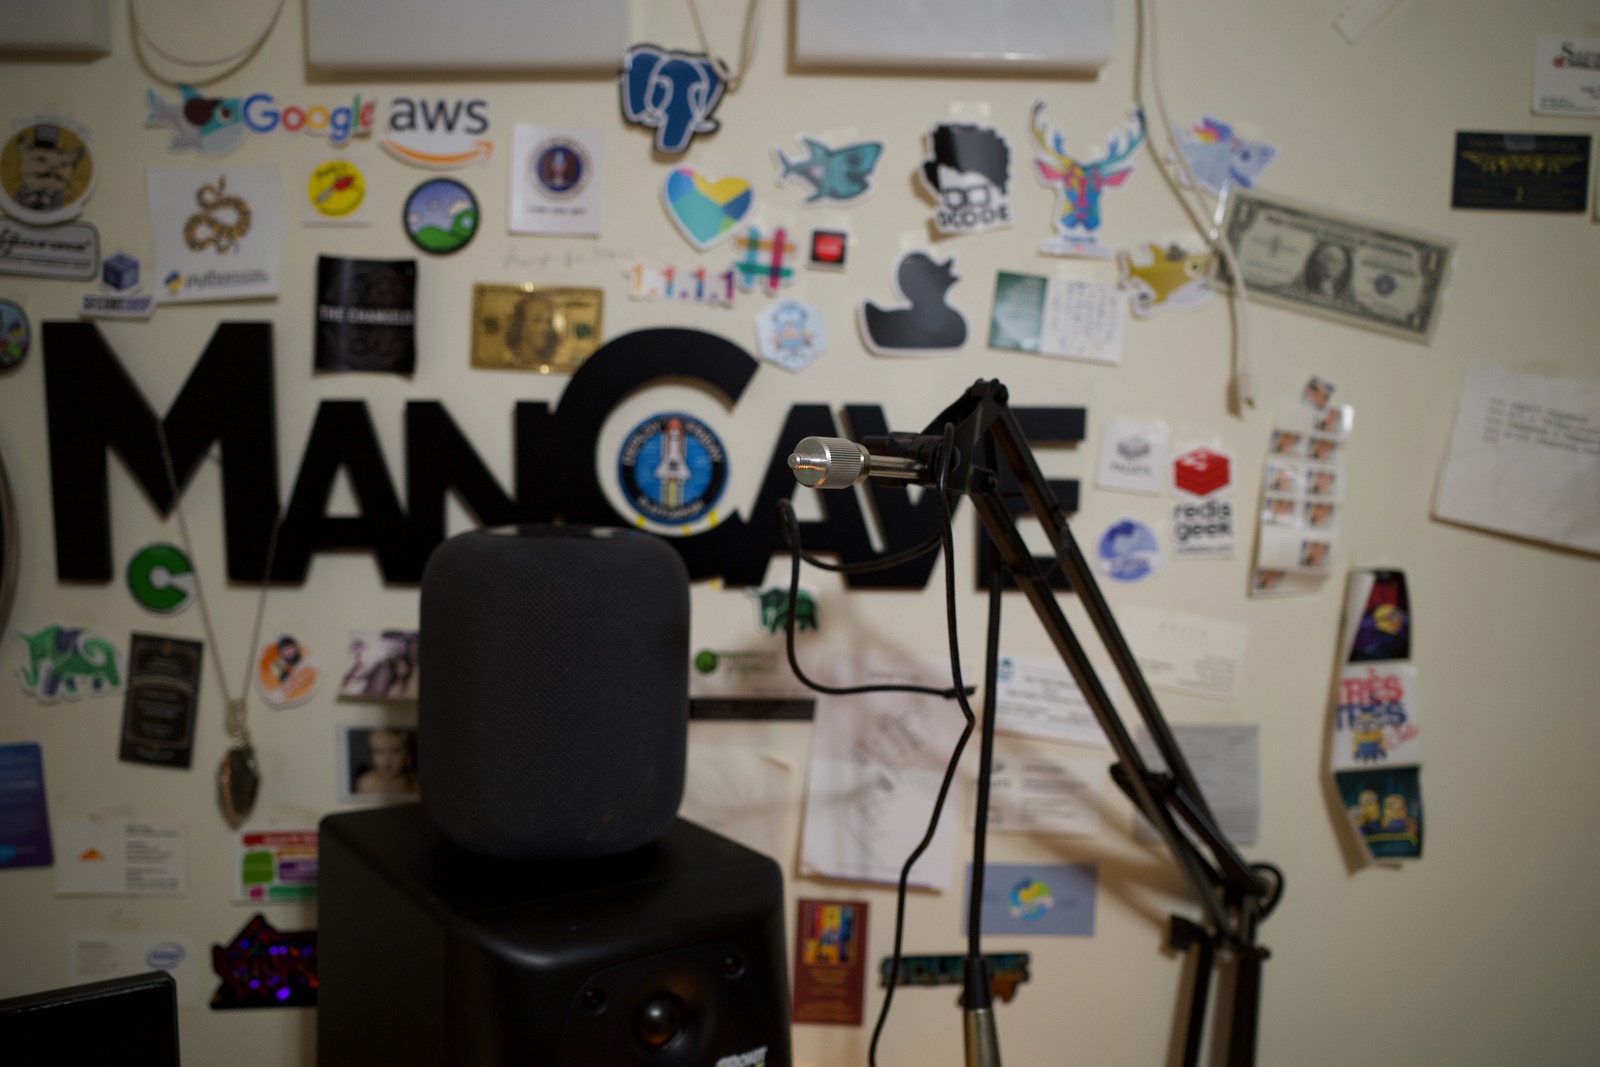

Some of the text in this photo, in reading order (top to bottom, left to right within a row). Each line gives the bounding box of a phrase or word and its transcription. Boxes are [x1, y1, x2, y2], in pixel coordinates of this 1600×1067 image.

[243, 94, 374, 141] Google
[390, 97, 490, 134] aws
[631, 263, 735, 301] 1.1.1.1
[1173, 499, 1233, 520] redis
[1174, 522, 1233, 545] geek
